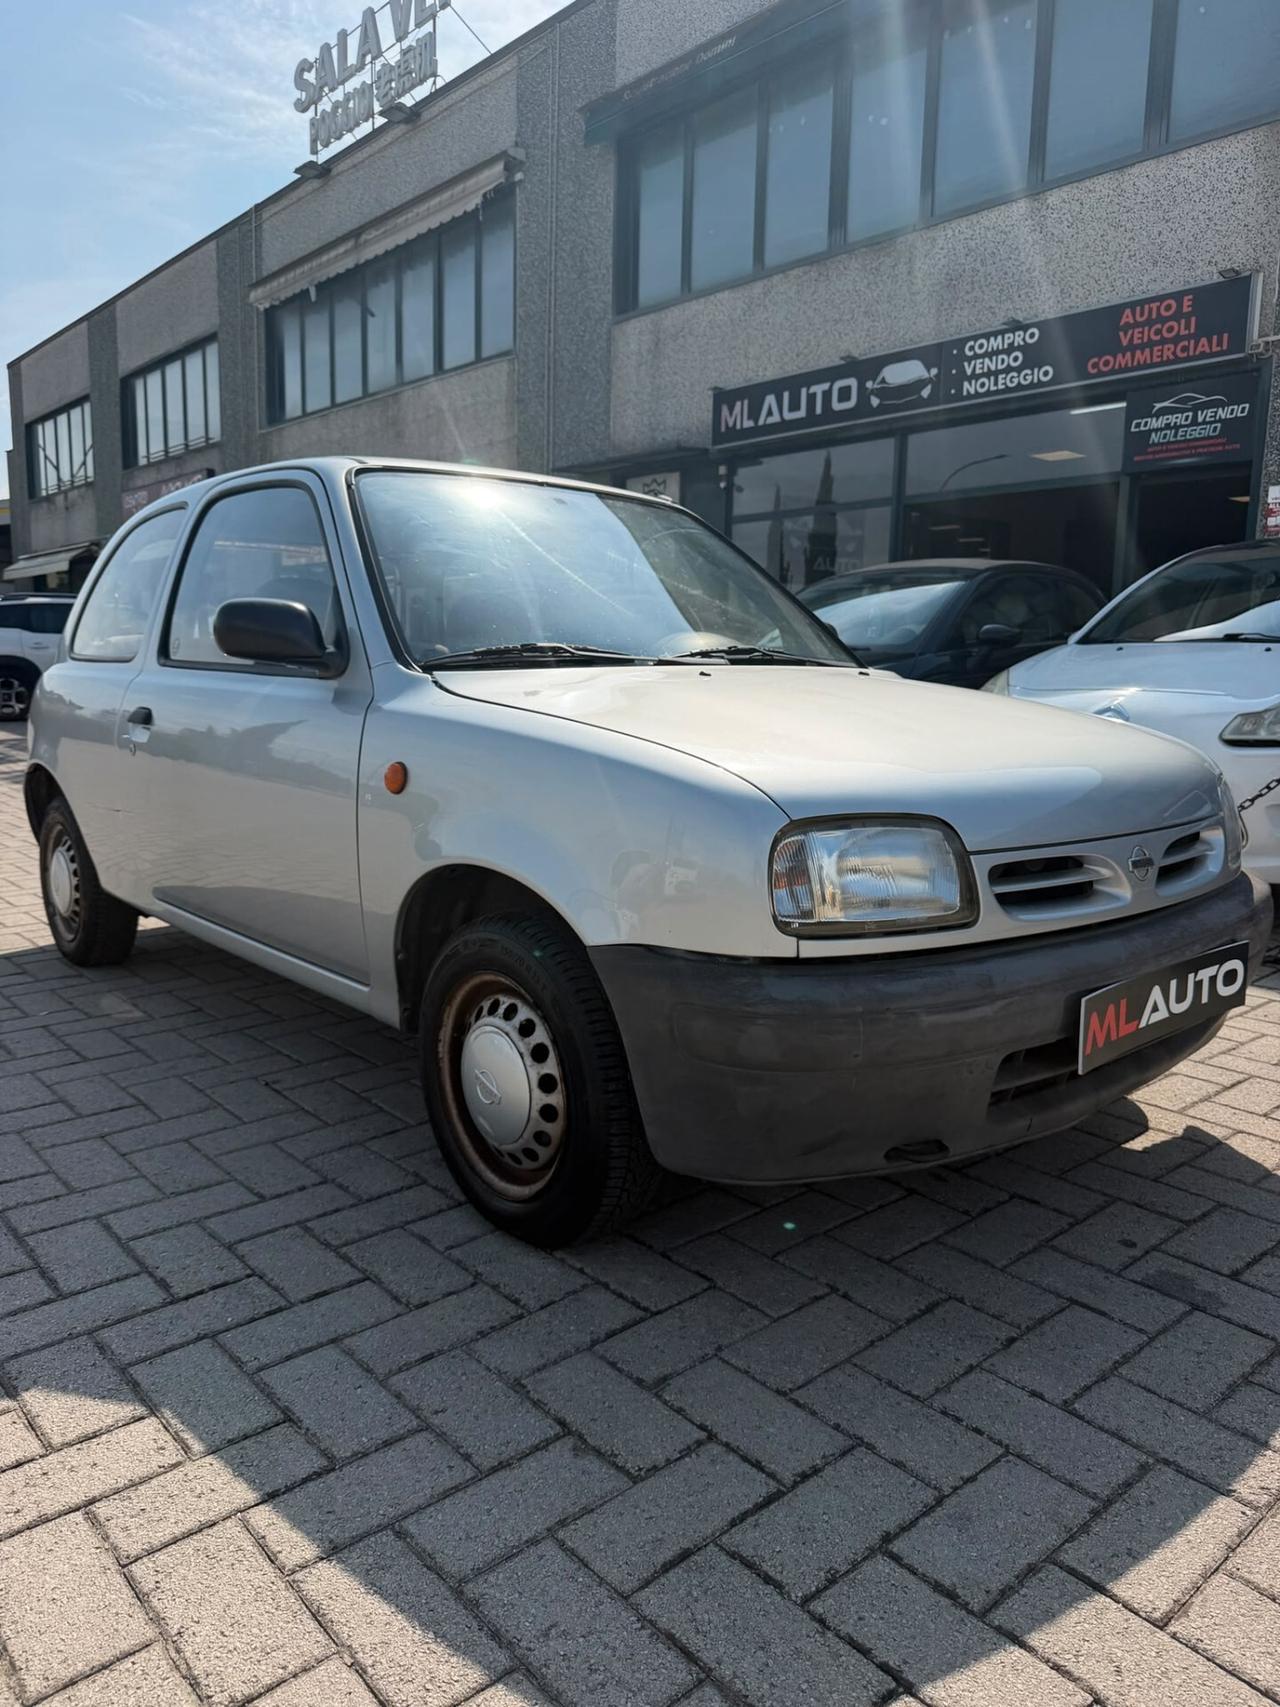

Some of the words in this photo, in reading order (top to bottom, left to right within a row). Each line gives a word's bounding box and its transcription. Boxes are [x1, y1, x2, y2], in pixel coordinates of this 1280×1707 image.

[293, 6, 384, 114] SALA
[1119, 299, 1177, 327] AUTO
[1182, 295, 1194, 314] E
[964, 327, 1040, 357] COMPRO
[1119, 316, 1196, 347] VEICOLI
[963, 351, 1024, 377] VENDO
[1087, 333, 1229, 375] COMMERCIALI
[962, 365, 1054, 397] NOLEGGIO
[1130, 411, 1194, 433] COMPRO
[1197, 403, 1250, 424] VENDO
[1149, 423, 1221, 445] NOLEGGIO
